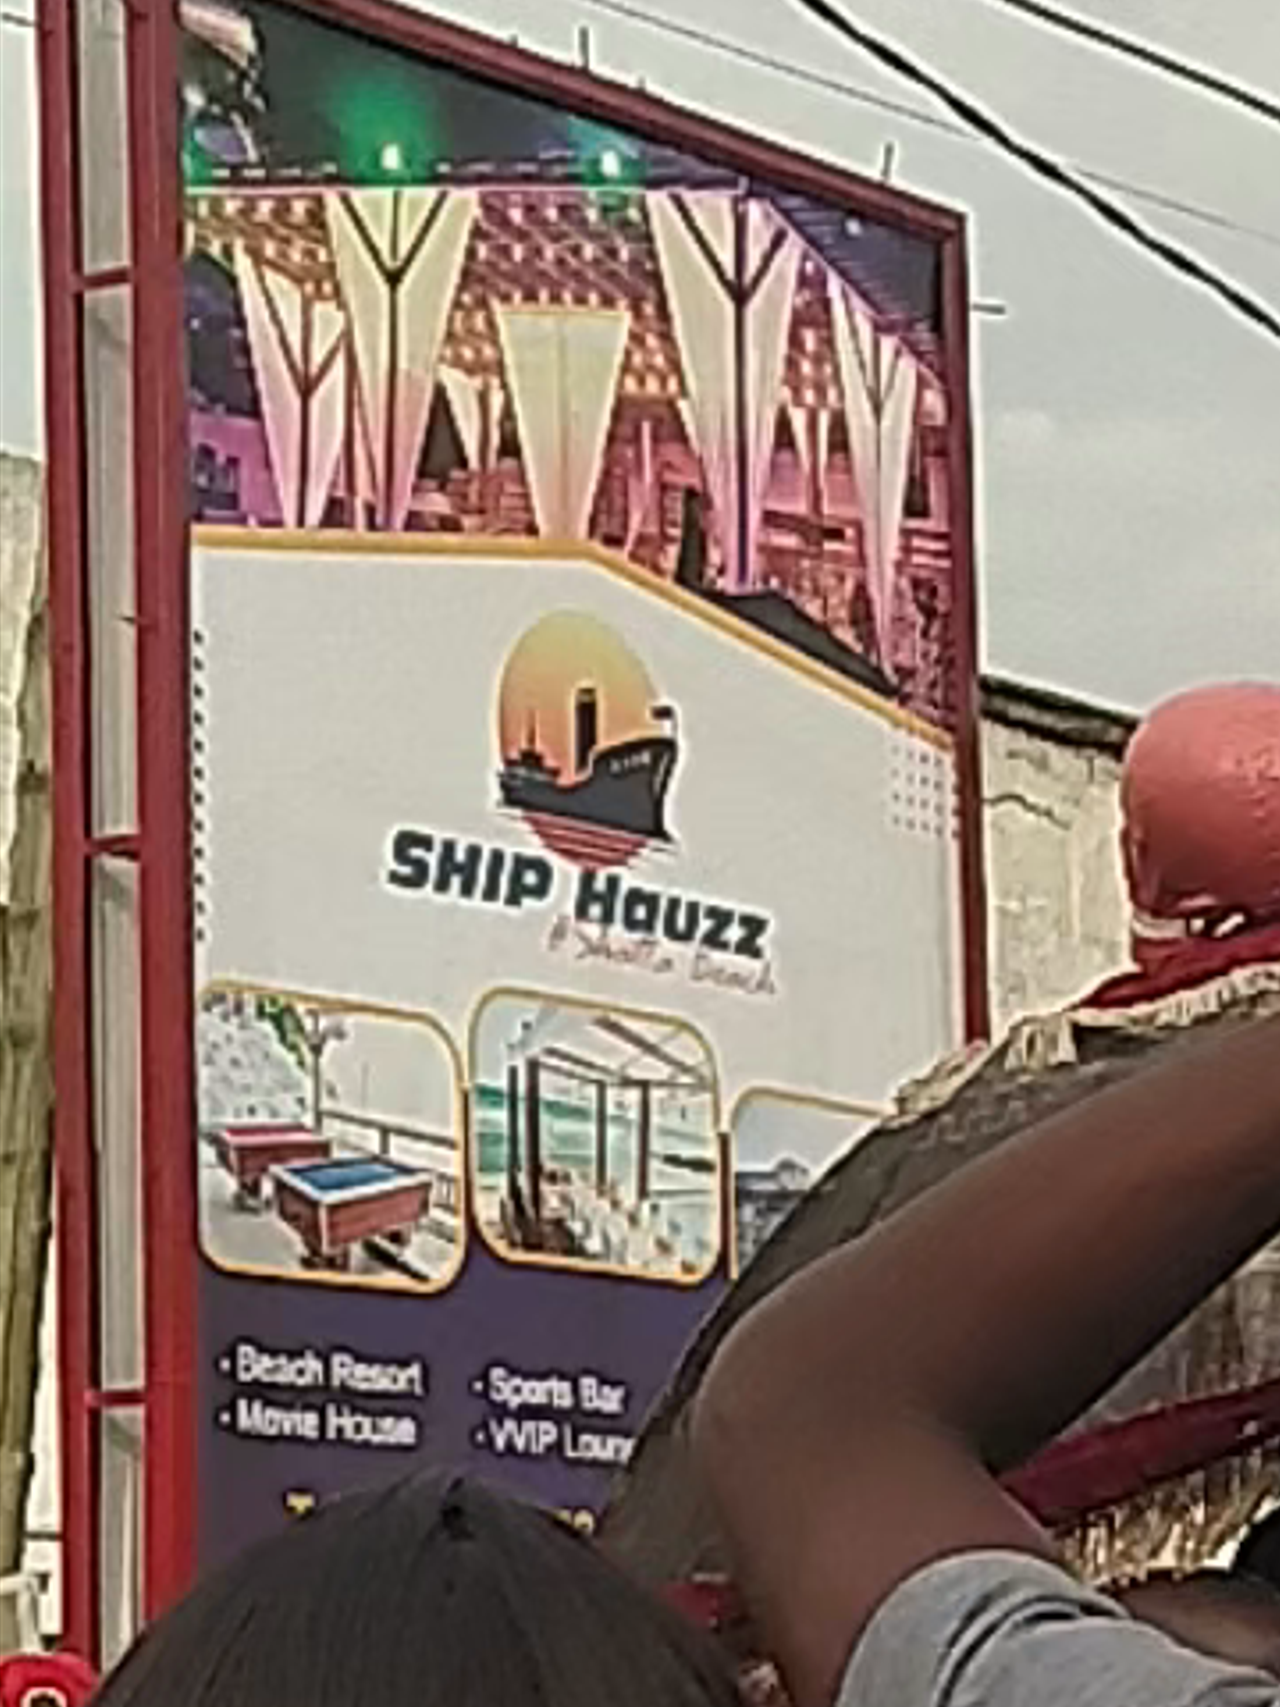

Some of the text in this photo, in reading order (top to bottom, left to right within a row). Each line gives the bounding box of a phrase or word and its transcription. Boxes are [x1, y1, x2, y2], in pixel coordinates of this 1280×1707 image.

[388, 830, 769, 959] SHIP Hauzz
[236, 1346, 423, 1394] Beach Resort
[489, 1368, 625, 1413] Sports Bar
[237, 1400, 417, 1445] Movie House
[489, 1420, 558, 1456] VVIP
